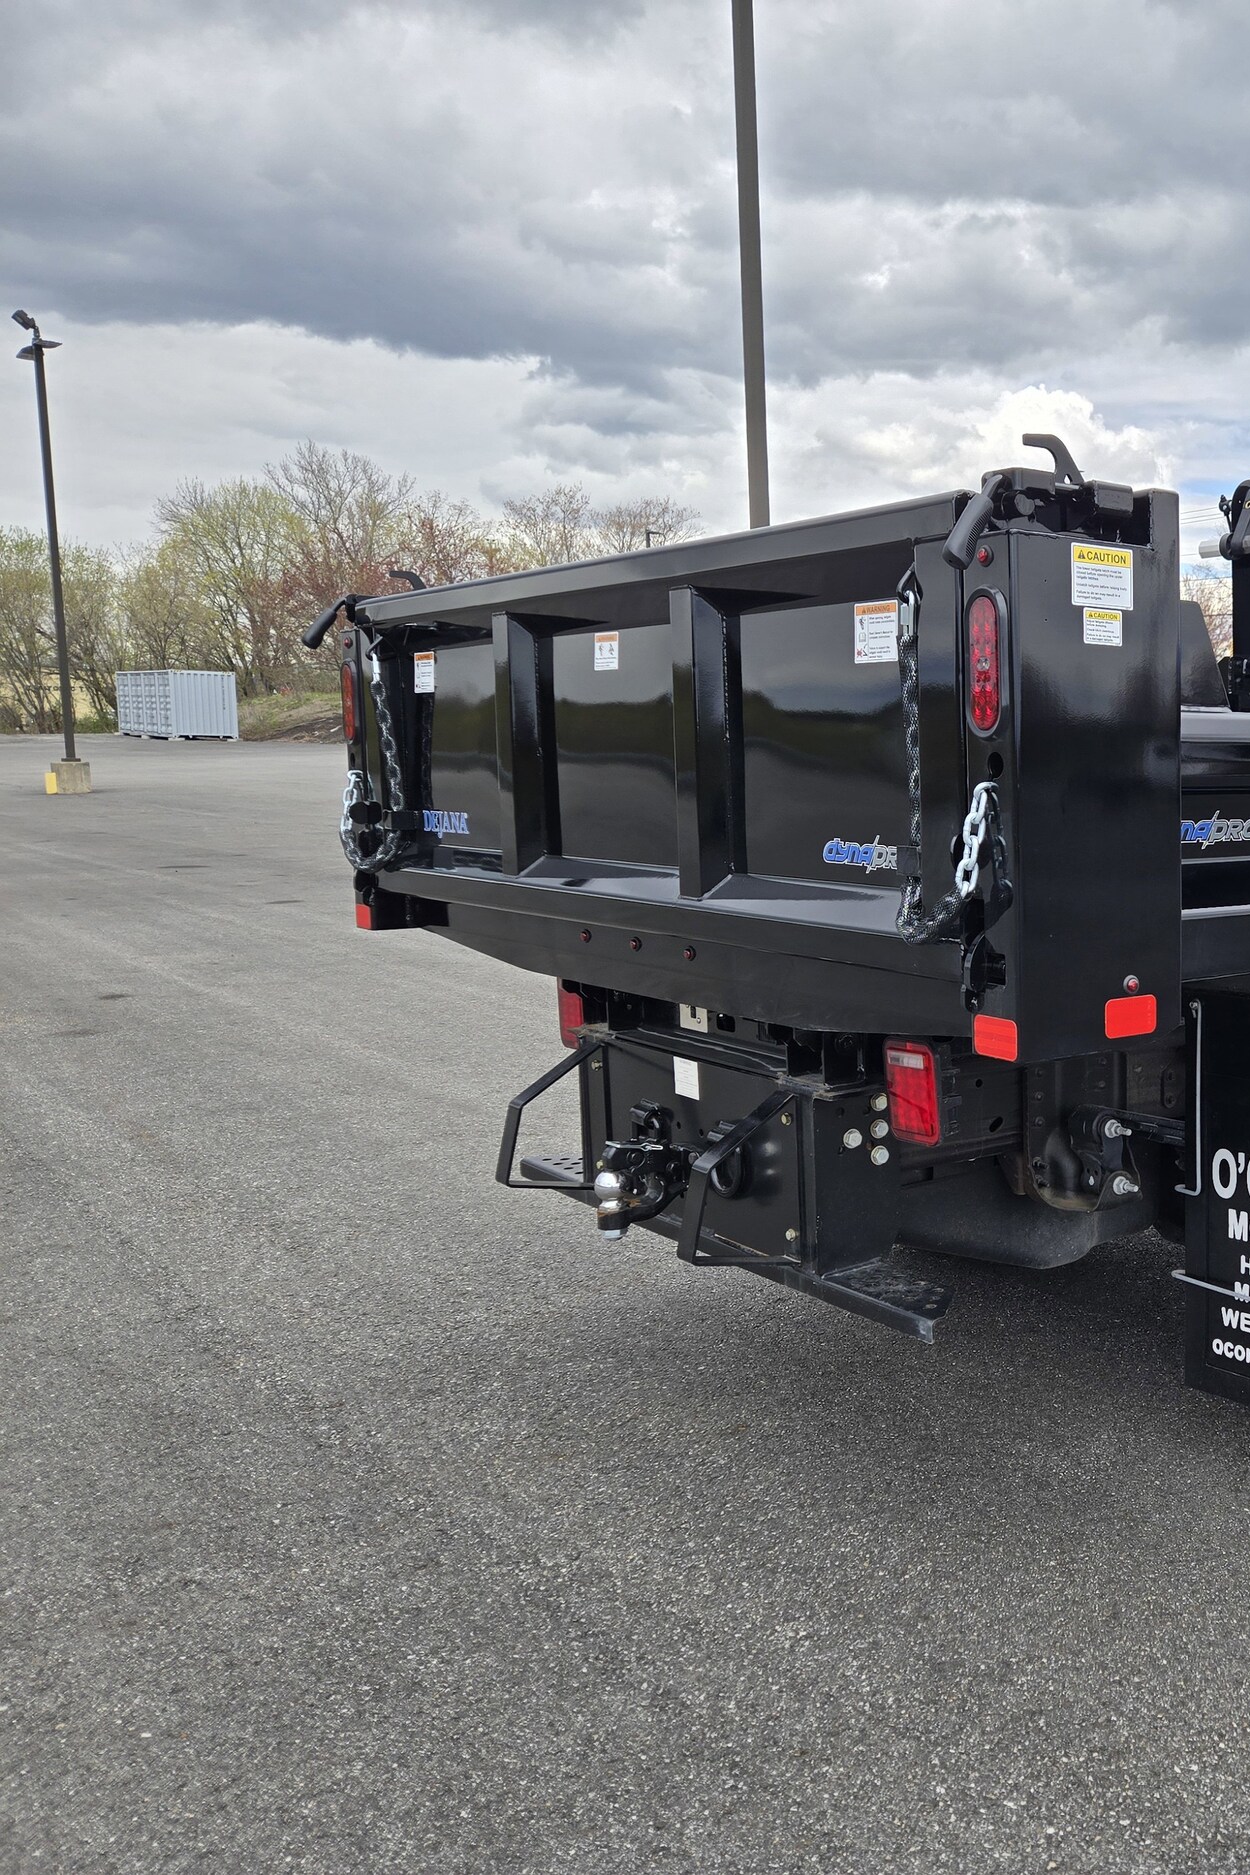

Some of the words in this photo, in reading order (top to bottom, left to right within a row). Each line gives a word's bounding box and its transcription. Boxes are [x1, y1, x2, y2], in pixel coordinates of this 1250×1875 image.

[1086, 550, 1126, 565] CAUTION
[1093, 612, 1118, 620] CAUTION
[422, 809, 470, 839] DEJANA
